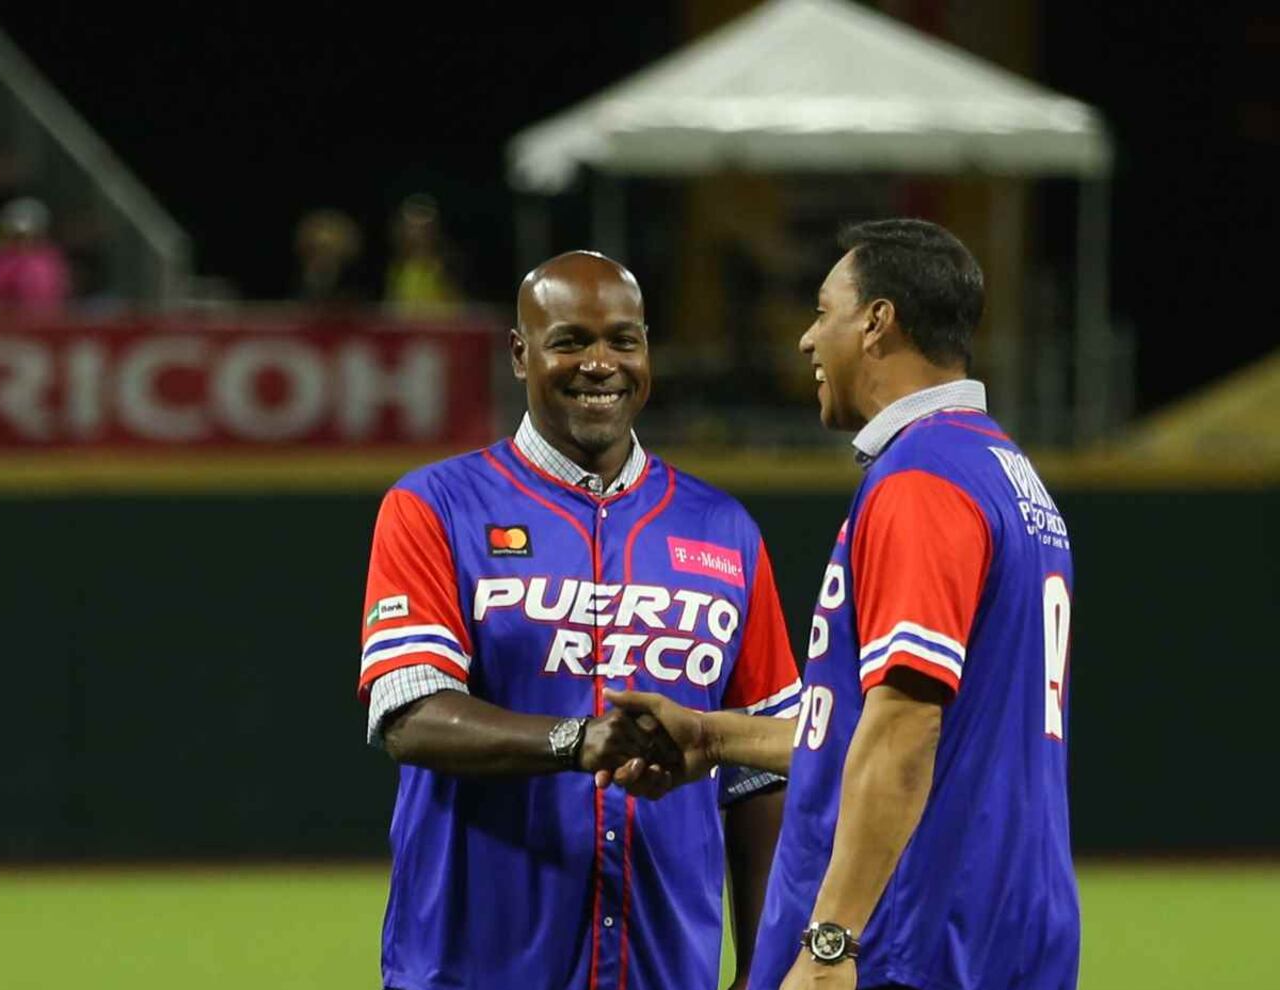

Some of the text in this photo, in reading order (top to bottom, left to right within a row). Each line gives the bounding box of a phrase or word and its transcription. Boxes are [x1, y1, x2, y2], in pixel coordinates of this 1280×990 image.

[474, 577, 739, 644] PUERTO
[545, 629, 723, 686] RICO
[793, 685, 834, 750] 19
